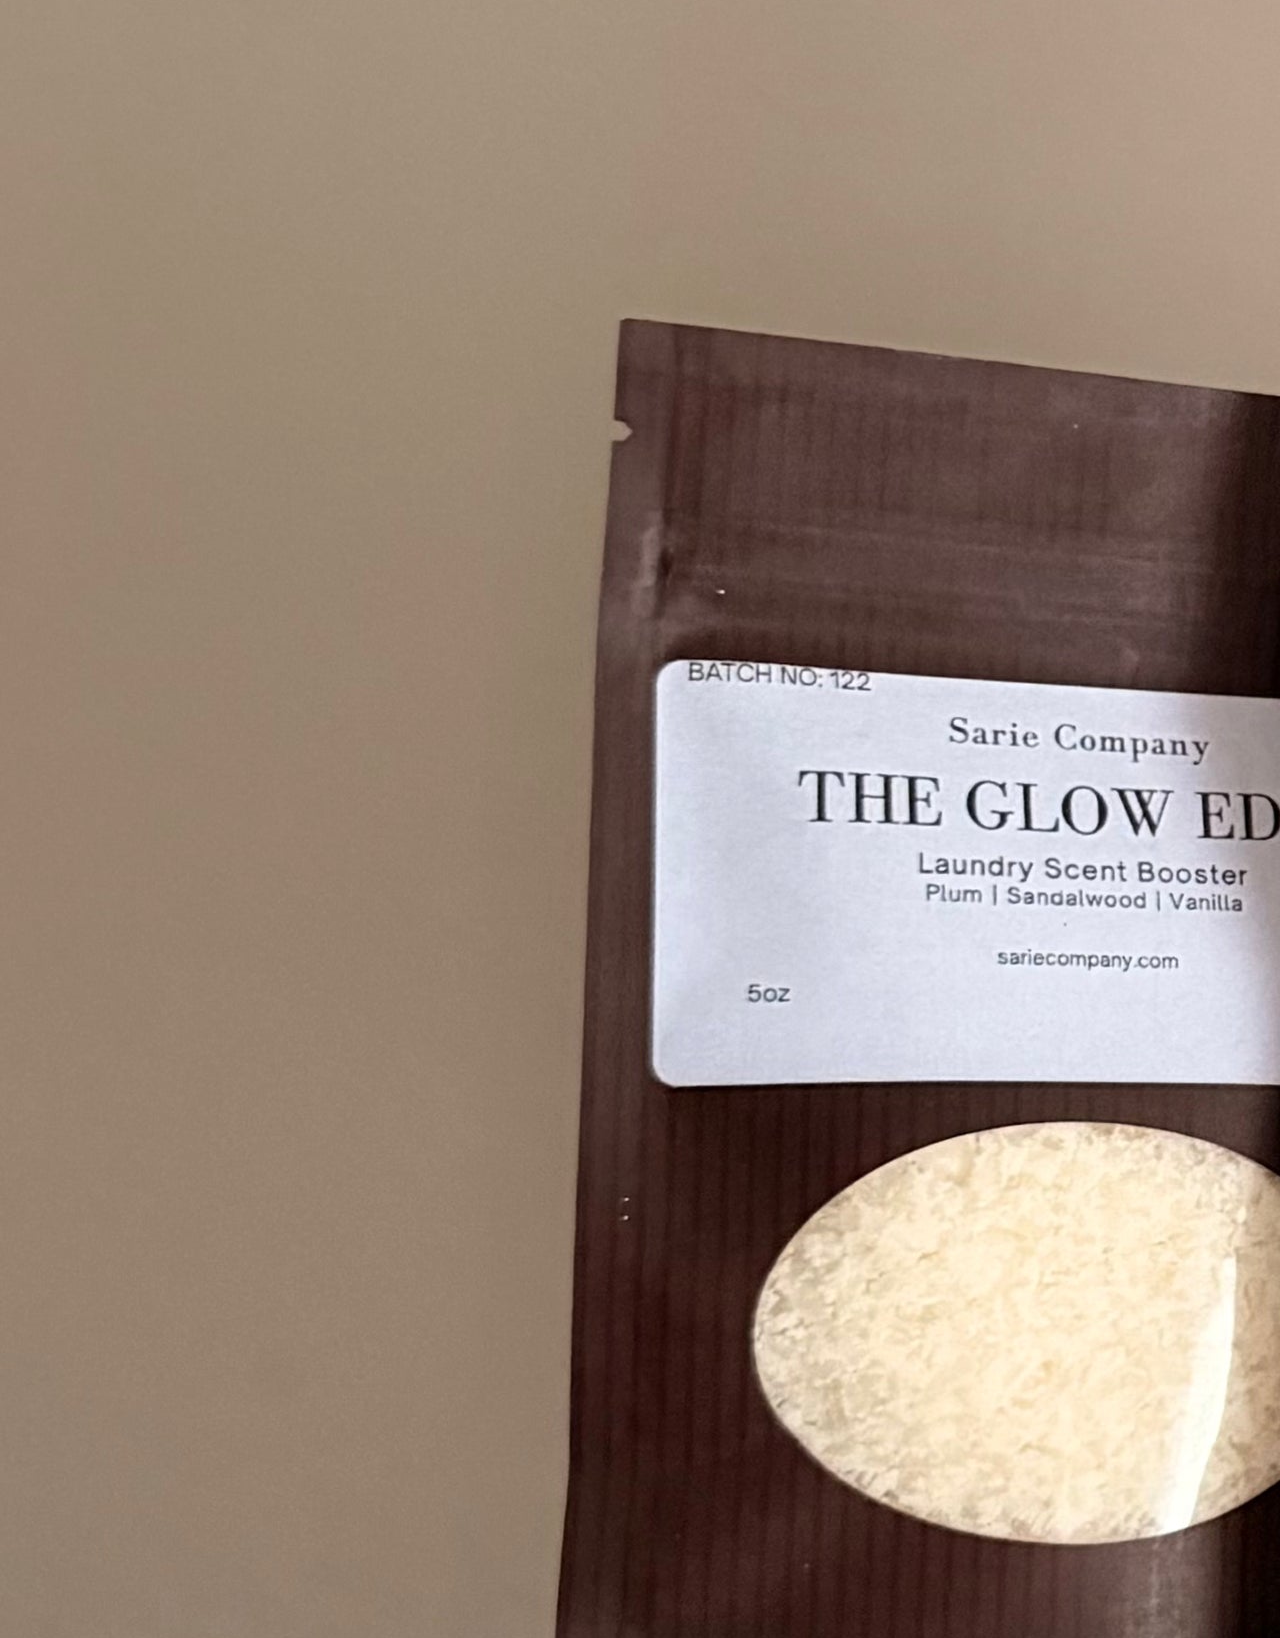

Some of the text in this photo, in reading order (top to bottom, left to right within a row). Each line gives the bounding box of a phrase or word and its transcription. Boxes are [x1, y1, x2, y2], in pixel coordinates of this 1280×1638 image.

[687, 661, 873, 692] BATCH NO: 122
[948, 716, 1211, 765] Sarie Company
[797, 770, 943, 827] THE
[965, 780, 1175, 837] GLOW
[918, 851, 1248, 887] Laundry Scent Booster
[925, 883, 983, 903] Plum
[1007, 886, 1148, 910] Sandalwood
[1168, 892, 1244, 913] Vanilla
[997, 948, 1179, 973] sariecompany.com
[747, 983, 791, 1003] 5oz
